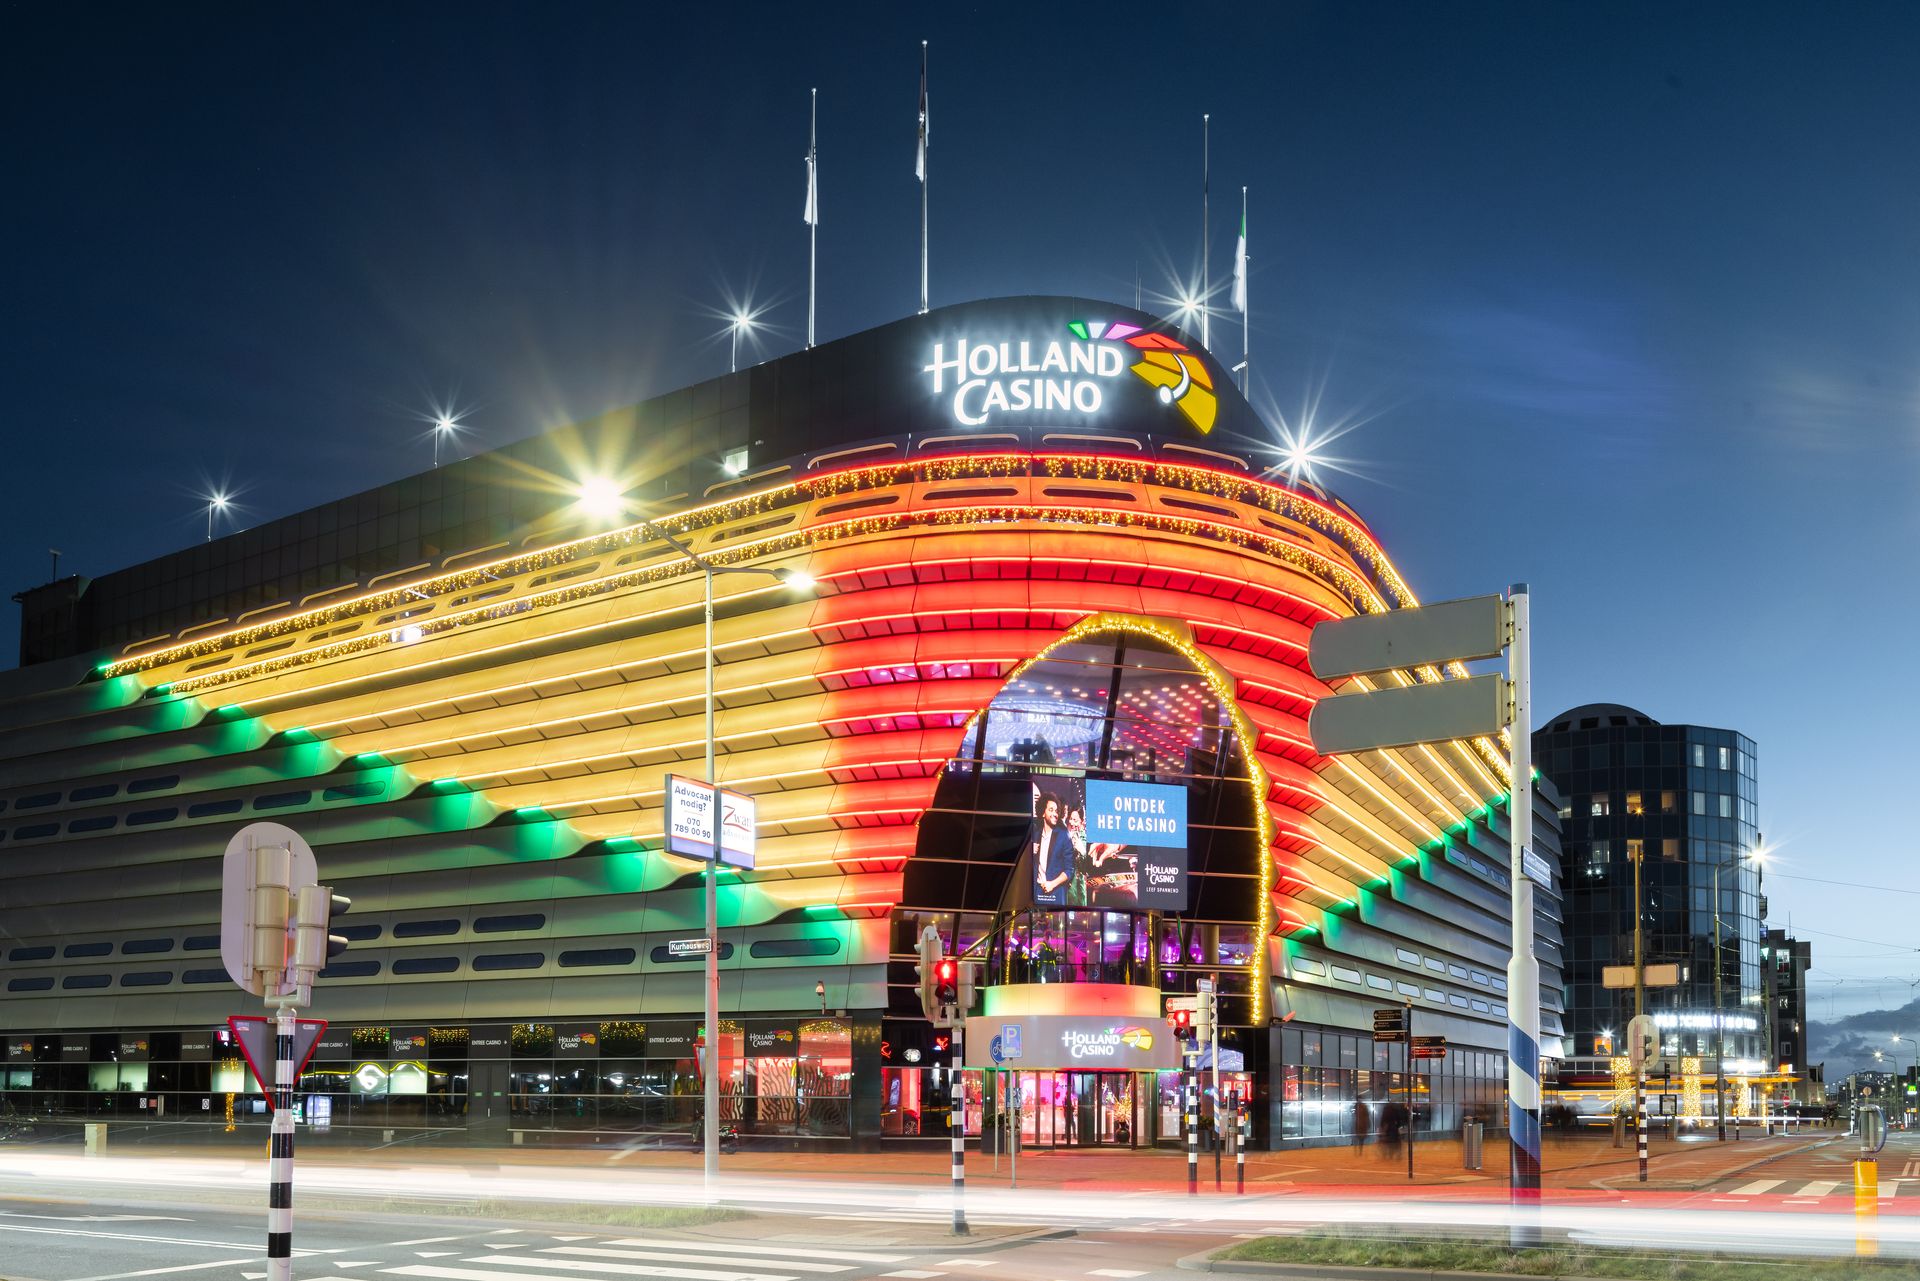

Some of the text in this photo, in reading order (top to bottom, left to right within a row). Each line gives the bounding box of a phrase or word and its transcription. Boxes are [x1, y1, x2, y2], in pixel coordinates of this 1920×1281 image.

[924, 339, 1124, 393] HOLLAND
[953, 378, 1103, 425] CASINO
[674, 785, 712, 802] Advocaat
[680, 798, 707, 812] nodig?
[1114, 796, 1166, 814] ONTDEK
[686, 817, 701, 827] 070
[1098, 814, 1177, 834] HET CASINO
[674, 823, 690, 834] 789
[691, 827, 701, 836] 00
[702, 829, 711, 839] 90
[1144, 863, 1179, 876] HOLLAND
[1150, 873, 1175, 885] CASINO
[671, 942, 710, 951] Kurhausweg
[558, 1036, 581, 1044] HOLLAND
[749, 1033, 776, 1041] HOLLAND
[1006, 1027, 1017, 1044] P
[1061, 1030, 1121, 1047] HOLLAND
[752, 1040, 773, 1048] CASINO
[1071, 1044, 1114, 1058] CASINO
